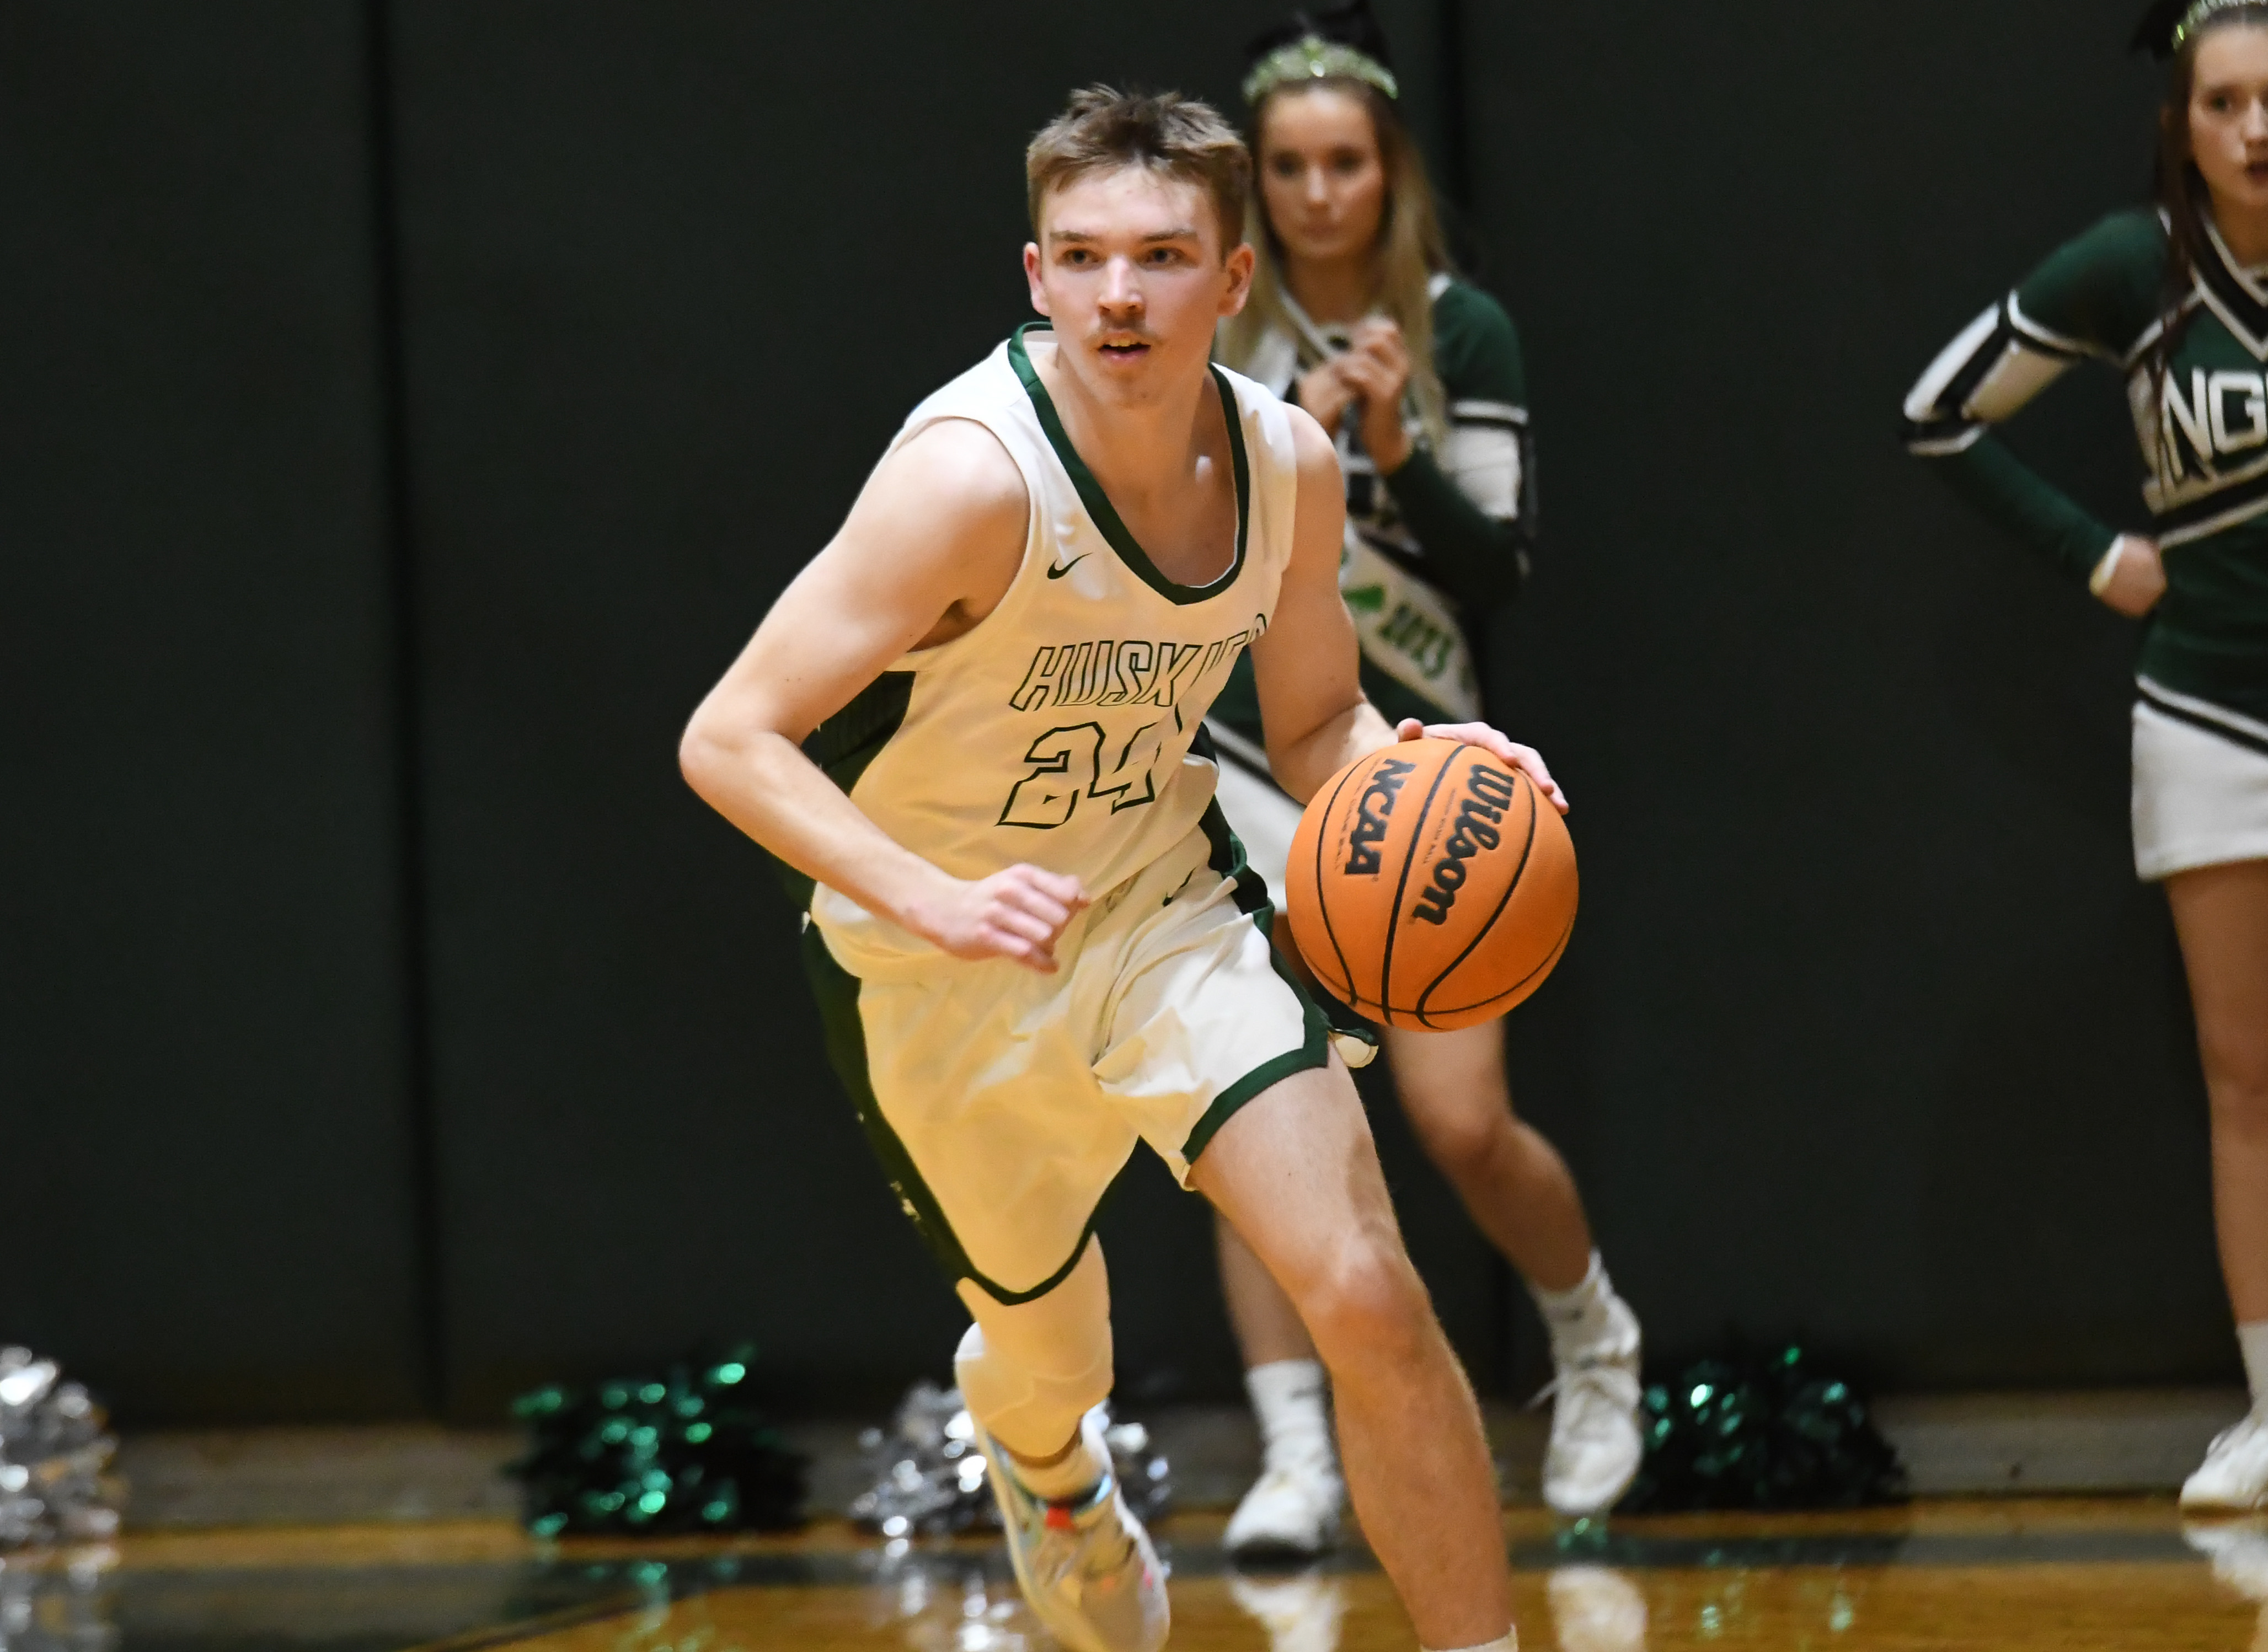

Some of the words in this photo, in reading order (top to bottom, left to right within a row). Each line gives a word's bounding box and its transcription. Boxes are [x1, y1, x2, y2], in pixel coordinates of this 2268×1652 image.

[2161, 366, 2268, 481] NG
[1008, 613, 1267, 711] HUSKI
[994, 704, 1183, 829] 24
[1345, 758, 1416, 875] NCAA
[1412, 764, 1515, 925] Wilson
